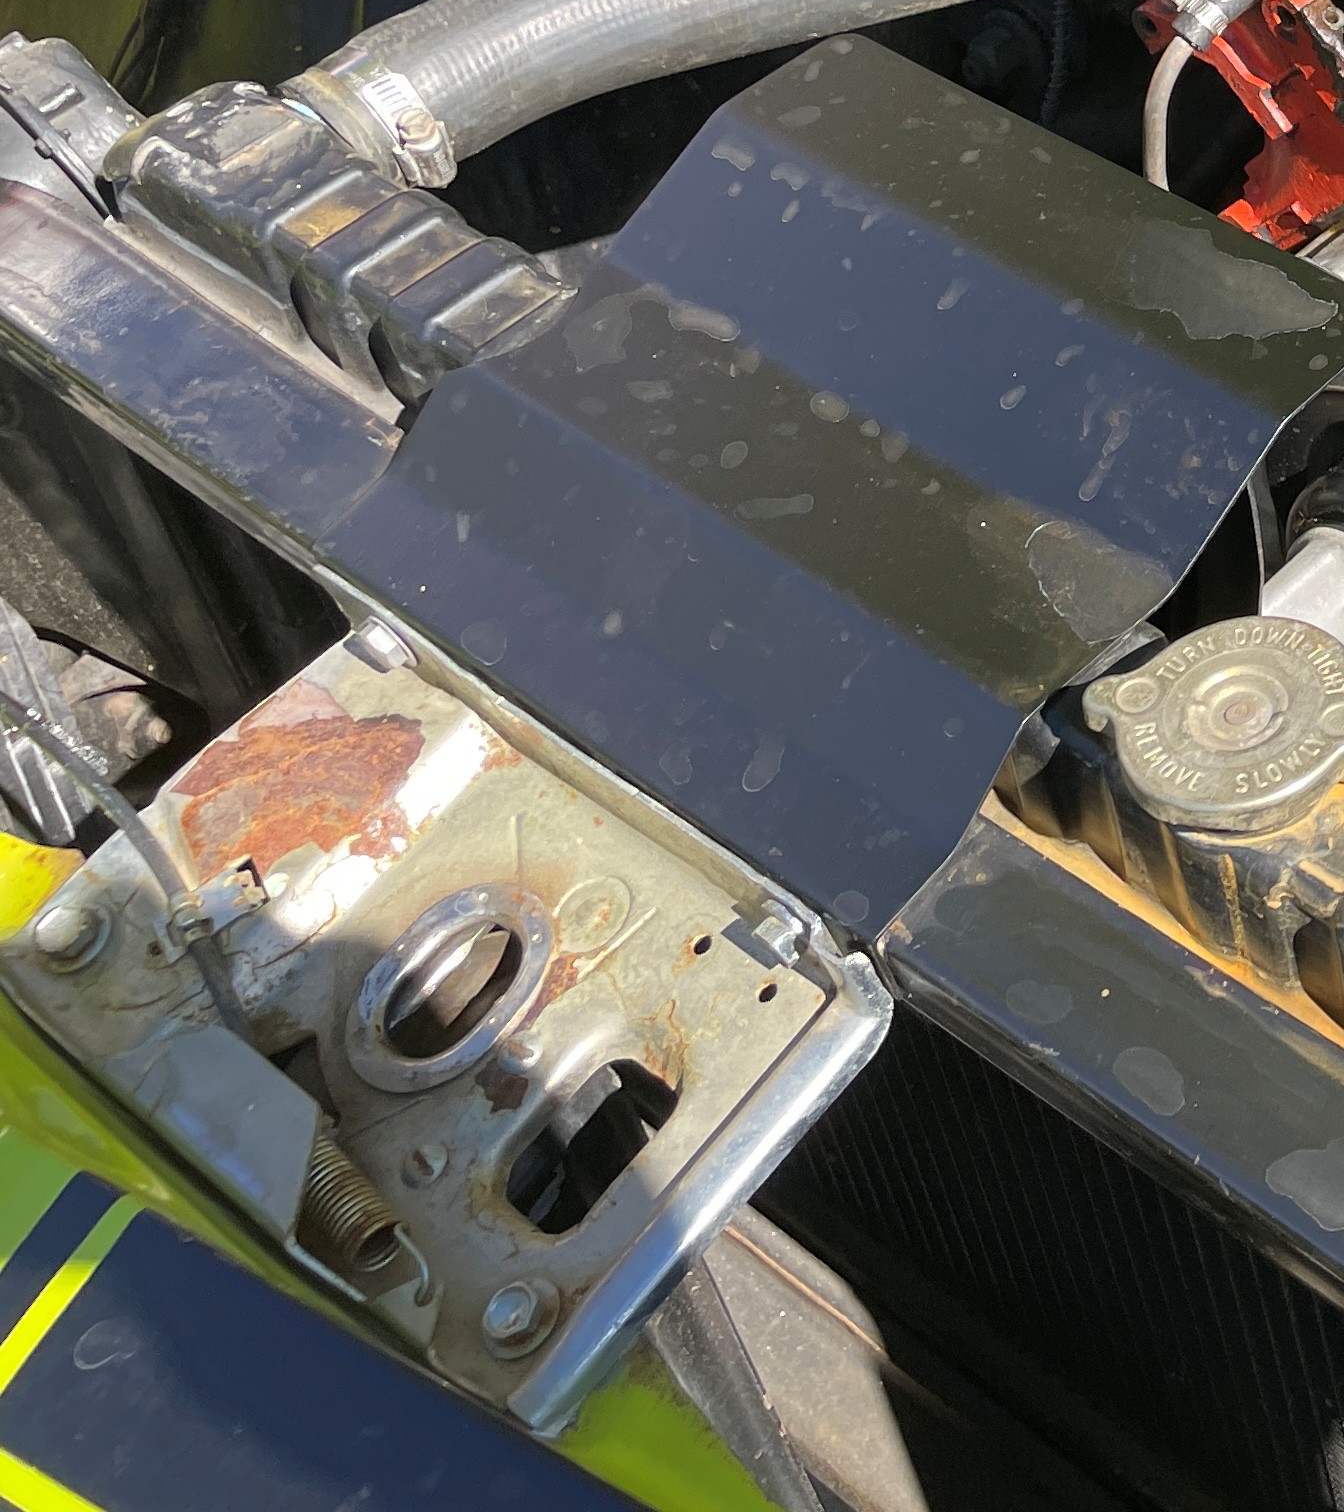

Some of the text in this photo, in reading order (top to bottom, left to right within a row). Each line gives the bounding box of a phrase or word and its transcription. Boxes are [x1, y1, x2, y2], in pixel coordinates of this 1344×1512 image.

[1156, 637, 1216, 680] TURN
[1234, 626, 1305, 650] DOWN
[1134, 721, 1326, 794] REMOVE SLOWLY
